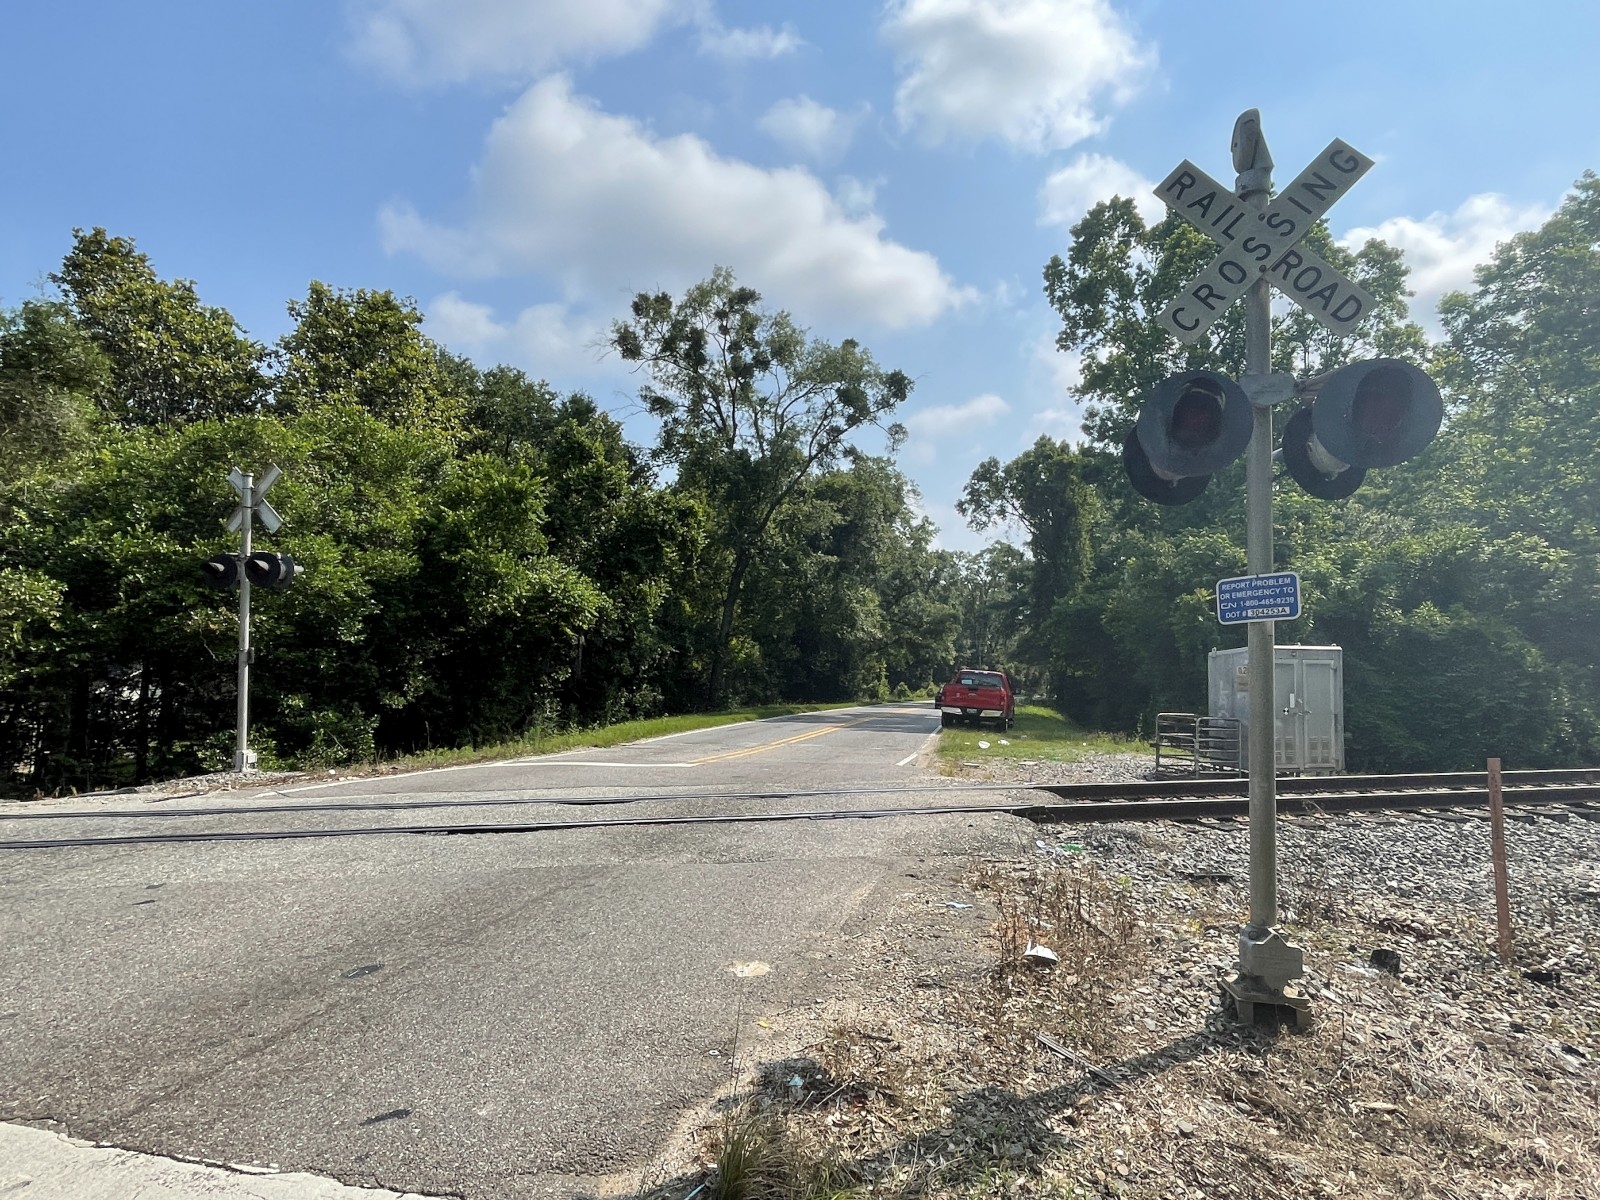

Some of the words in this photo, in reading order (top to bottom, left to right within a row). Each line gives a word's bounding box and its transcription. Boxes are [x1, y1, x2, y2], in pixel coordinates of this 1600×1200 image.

[1172, 150, 1359, 332] CROSSING
[1221, 581, 1250, 591] REPORT
[1252, 577, 1291, 588] PROBLEM
[1232, 588, 1281, 598] EMERGENCY
[1283, 586, 1294, 594] TO
[1240, 596, 1295, 607] 1-800-465-9239
